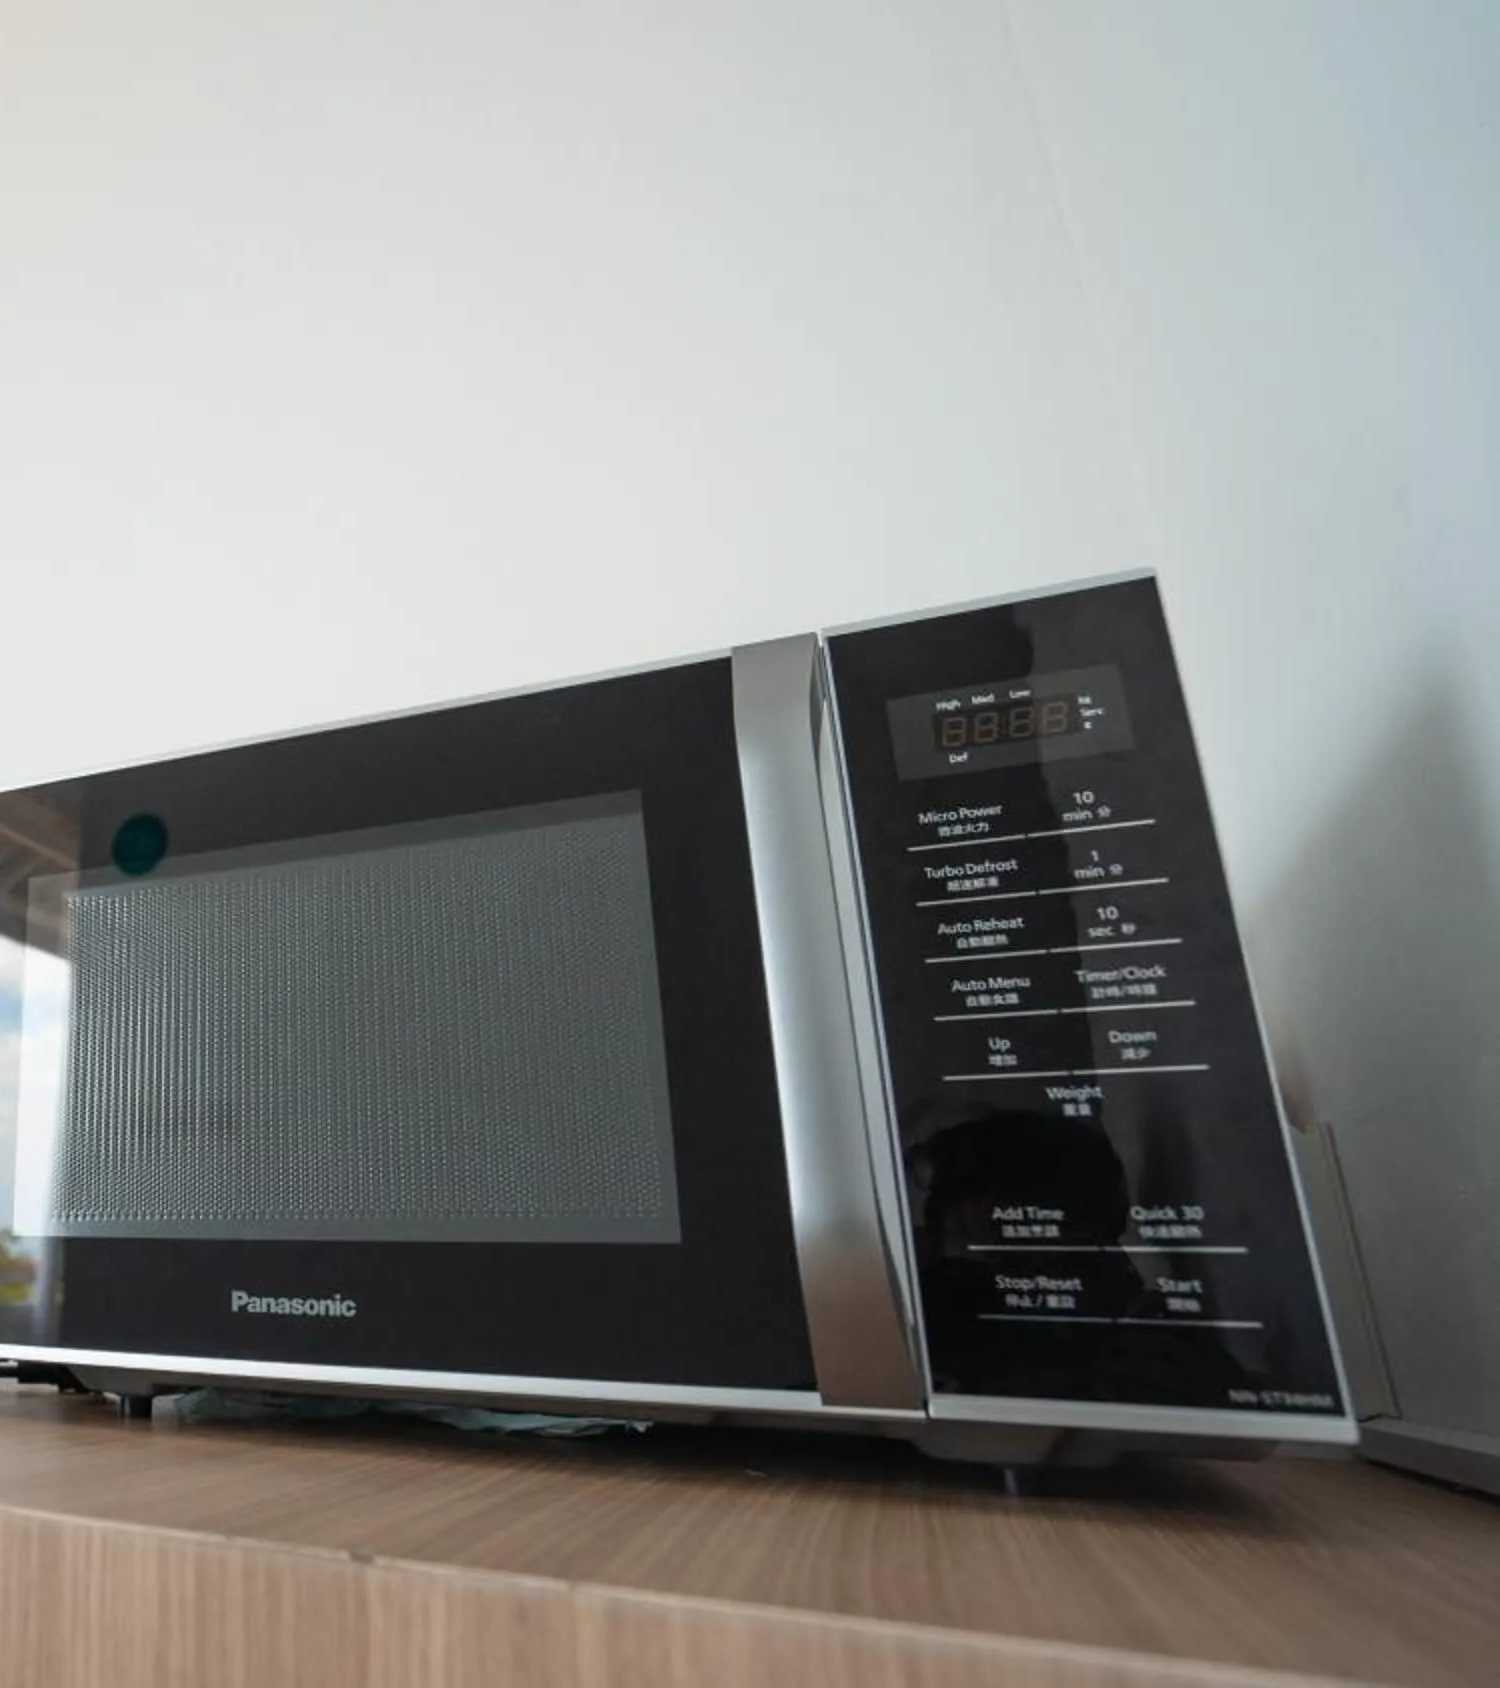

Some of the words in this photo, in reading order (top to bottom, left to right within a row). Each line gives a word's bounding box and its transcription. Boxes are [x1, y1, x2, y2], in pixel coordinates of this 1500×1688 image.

[949, 752, 969, 764] Def
[1072, 790, 1095, 805] 10
[918, 807, 958, 825] Micro
[959, 804, 1003, 820] Power
[1062, 808, 1093, 822] min
[1090, 850, 1100, 863] 1
[924, 865, 965, 880] Turbo
[965, 858, 1018, 875] Defrost
[1074, 865, 1105, 879] min
[1096, 905, 1119, 921] 10
[937, 922, 972, 936] Auto
[974, 916, 1025, 932] Reheat
[1088, 924, 1114, 938] sec
[1074, 964, 1166, 983] Timer/Clock
[951, 978, 987, 992] Auto
[989, 975, 1031, 989] Menu
[988, 1037, 1011, 1051] Up
[1108, 1030, 1157, 1044] Down
[1045, 1085, 1103, 1103] Weight
[992, 1206, 1024, 1221] Add
[1025, 1206, 1065, 1220] Time
[1129, 1205, 1178, 1221] Quick
[1182, 1206, 1204, 1221] 30
[995, 1275, 1083, 1292] Stop/Reset
[1156, 1276, 1203, 1293] Start
[231, 1289, 357, 1317] Panasonic
